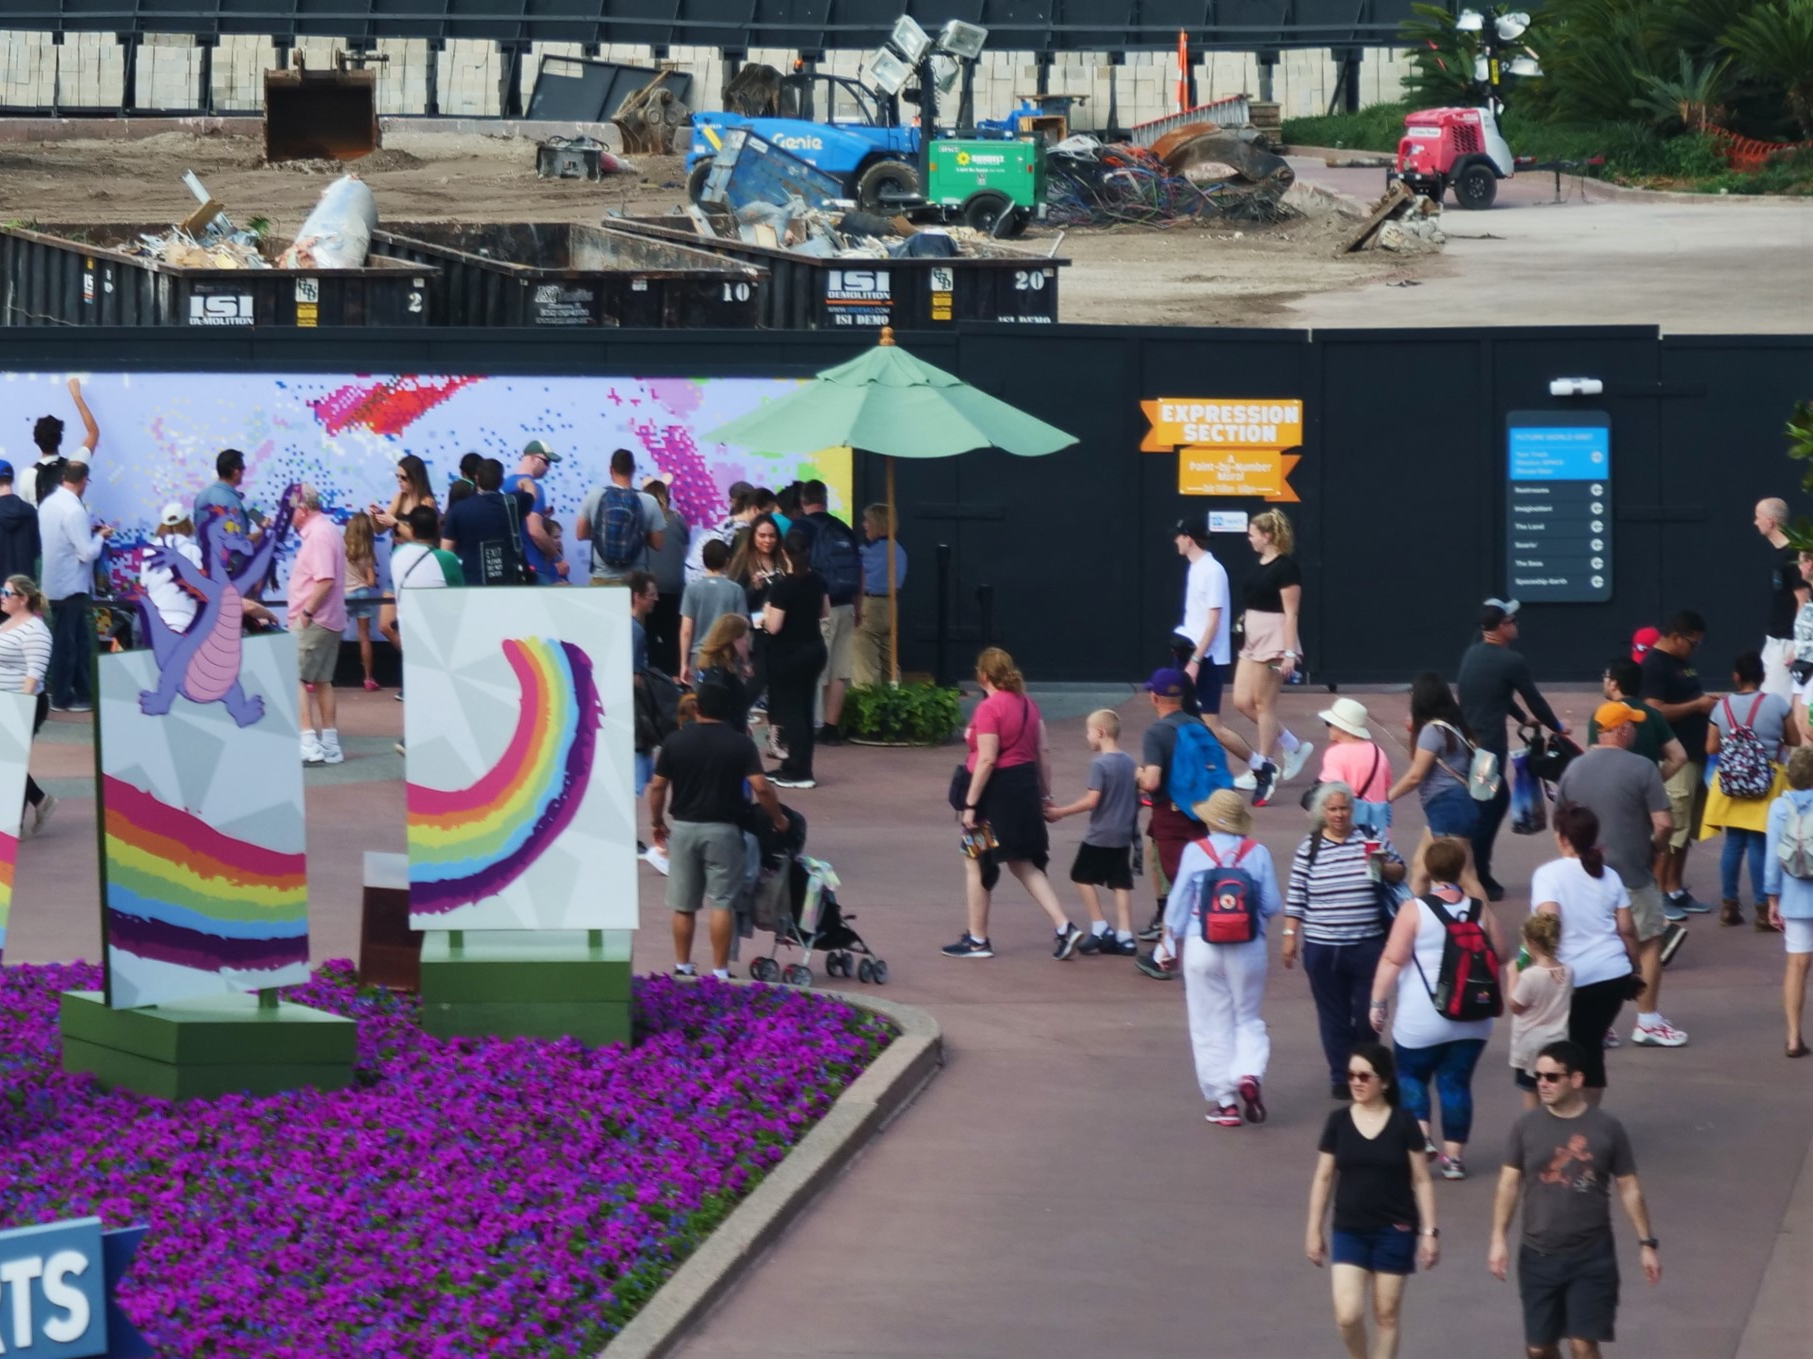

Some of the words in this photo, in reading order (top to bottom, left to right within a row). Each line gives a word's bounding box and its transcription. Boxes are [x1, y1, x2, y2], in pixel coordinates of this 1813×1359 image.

[772, 133, 822, 150] Genie
[829, 270, 890, 291] ISI
[1015, 271, 1045, 290] 20
[723, 283, 750, 302] 10
[828, 291, 890, 299] DEMOLITION
[190, 296, 254, 317] ISI
[408, 292, 423, 313] 2
[189, 317, 255, 326] DEMOLITION
[835, 314, 852, 325] ISI
[856, 314, 889, 325] DEMO
[1162, 405, 1299, 424] EXPRESSION
[1184, 424, 1277, 442] SECTION
